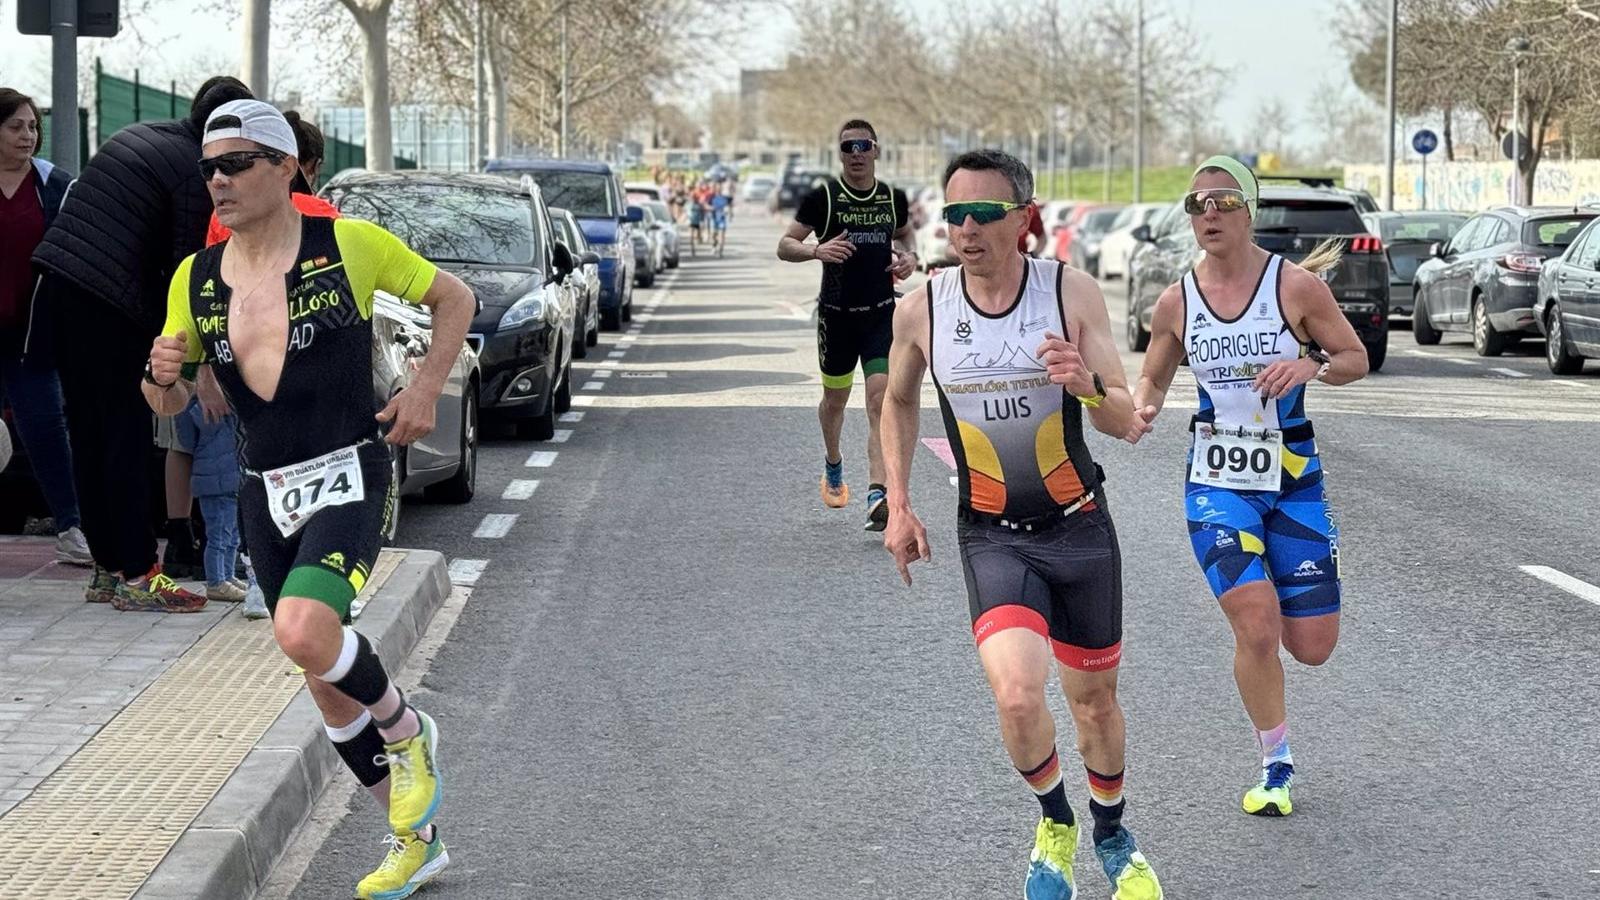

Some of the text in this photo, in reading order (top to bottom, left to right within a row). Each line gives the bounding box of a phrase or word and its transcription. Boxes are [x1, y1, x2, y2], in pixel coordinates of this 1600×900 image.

[836, 212, 892, 225] TOMELLOSO
[847, 228, 887, 244] arramolino
[1191, 332, 1281, 364] RODRIGUEZ
[983, 396, 1032, 422] LUIS
[295, 461, 326, 476] DUATLÓN
[1207, 444, 1271, 474] 090
[282, 471, 352, 514] 074
